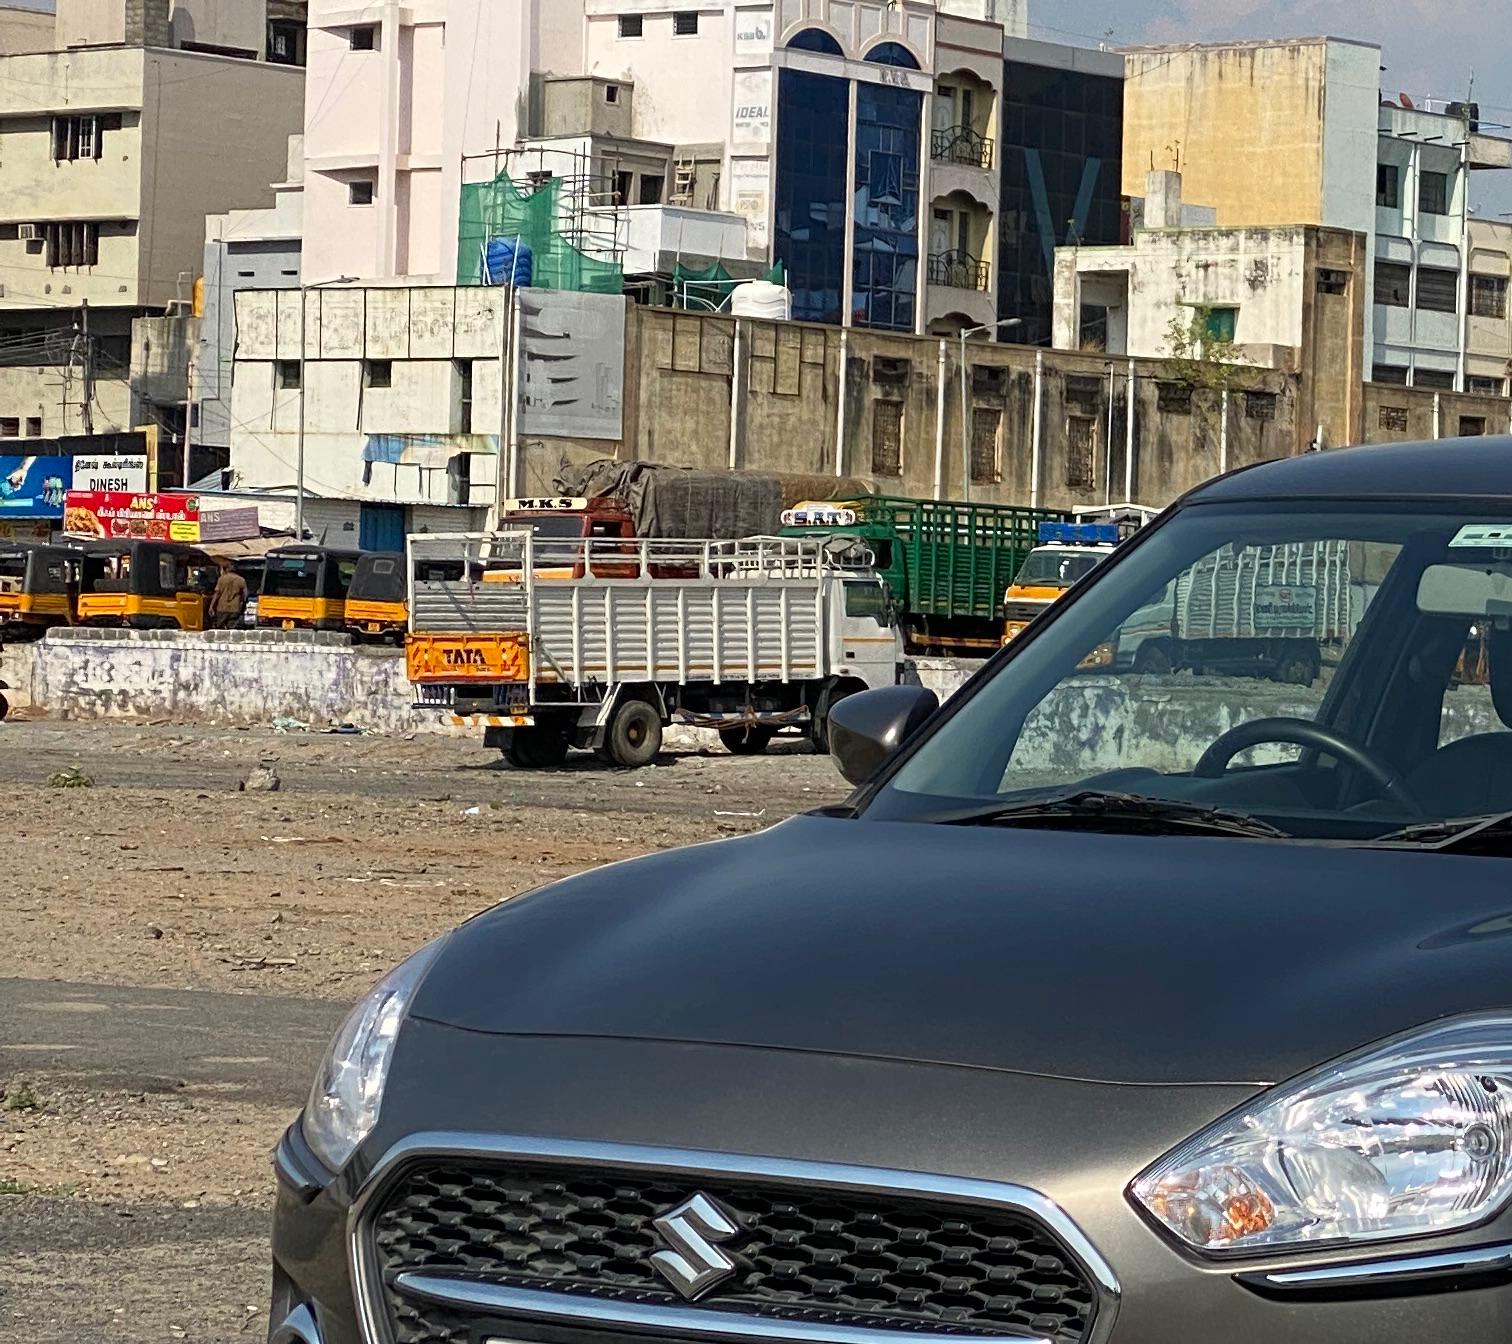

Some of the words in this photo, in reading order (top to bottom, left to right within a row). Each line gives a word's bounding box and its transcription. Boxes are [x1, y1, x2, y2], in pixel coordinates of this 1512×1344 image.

[735, 105, 769, 119] IDEAL
[90, 478, 128, 491] DINESH
[130, 495, 154, 510] ANS
[442, 648, 487, 665] TATA
